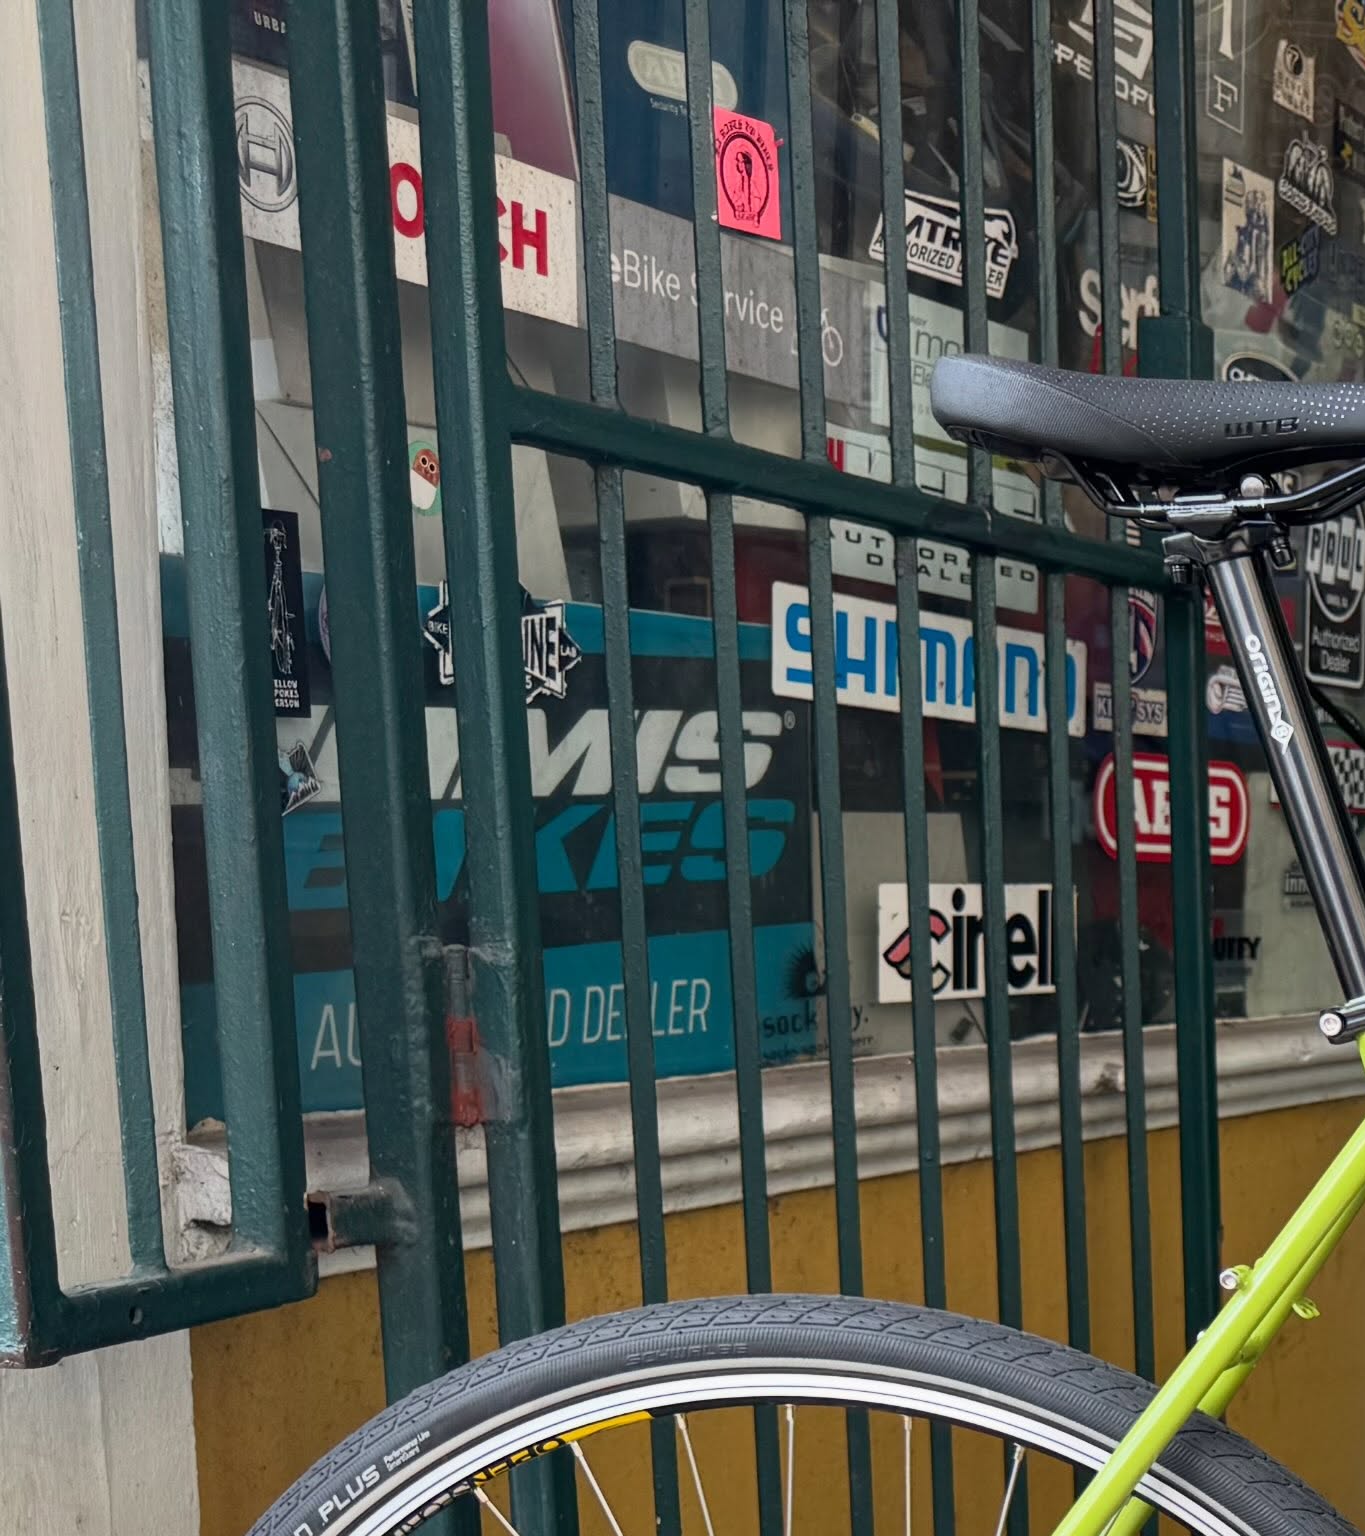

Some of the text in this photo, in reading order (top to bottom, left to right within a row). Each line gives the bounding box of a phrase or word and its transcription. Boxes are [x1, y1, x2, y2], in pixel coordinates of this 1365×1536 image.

[1309, 525, 1365, 574] PAUL
[866, 552, 972, 586] DALE
[427, 621, 448, 634] BIKE
[1311, 627, 1361, 653] Authorized
[1320, 651, 1352, 671] Dealer
[273, 689, 300, 699] POKES
[1134, 777, 1231, 839] ABS
[581, 977, 711, 1046] DELER
[317, 1464, 382, 1524] PLUS
